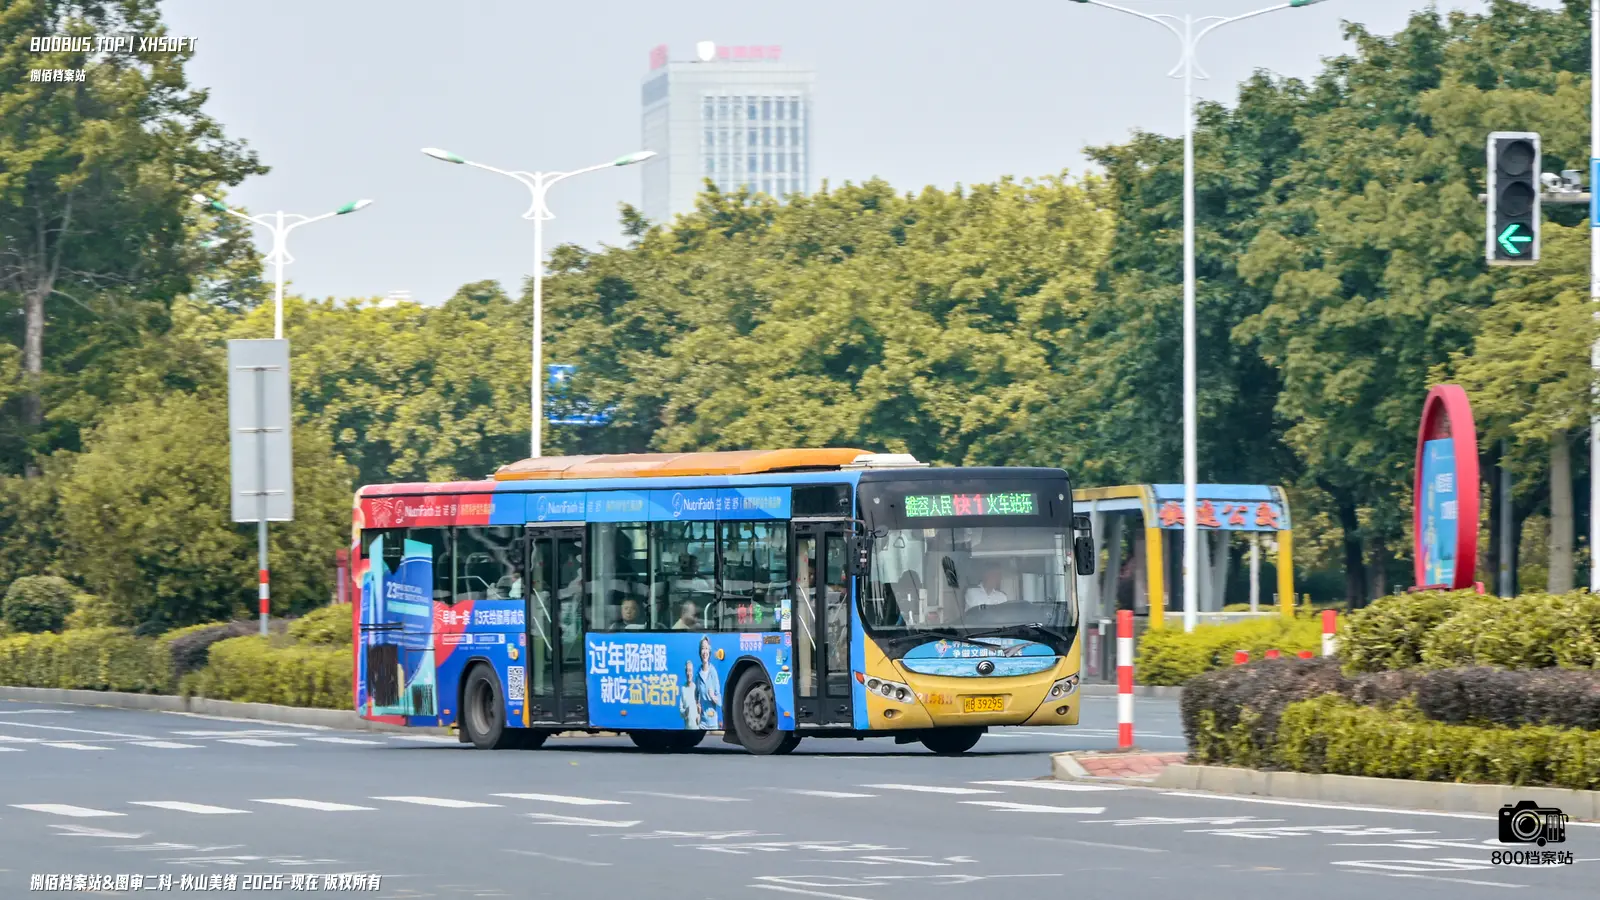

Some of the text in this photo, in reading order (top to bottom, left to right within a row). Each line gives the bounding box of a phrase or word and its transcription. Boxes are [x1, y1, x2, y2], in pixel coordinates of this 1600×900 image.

[953, 493, 983, 516] 快1
[986, 493, 1033, 515] 火车站东
[589, 641, 668, 674] 过年肠舒服
[600, 673, 679, 706] 就吃益诺舒
[775, 672, 791, 684] BRT
